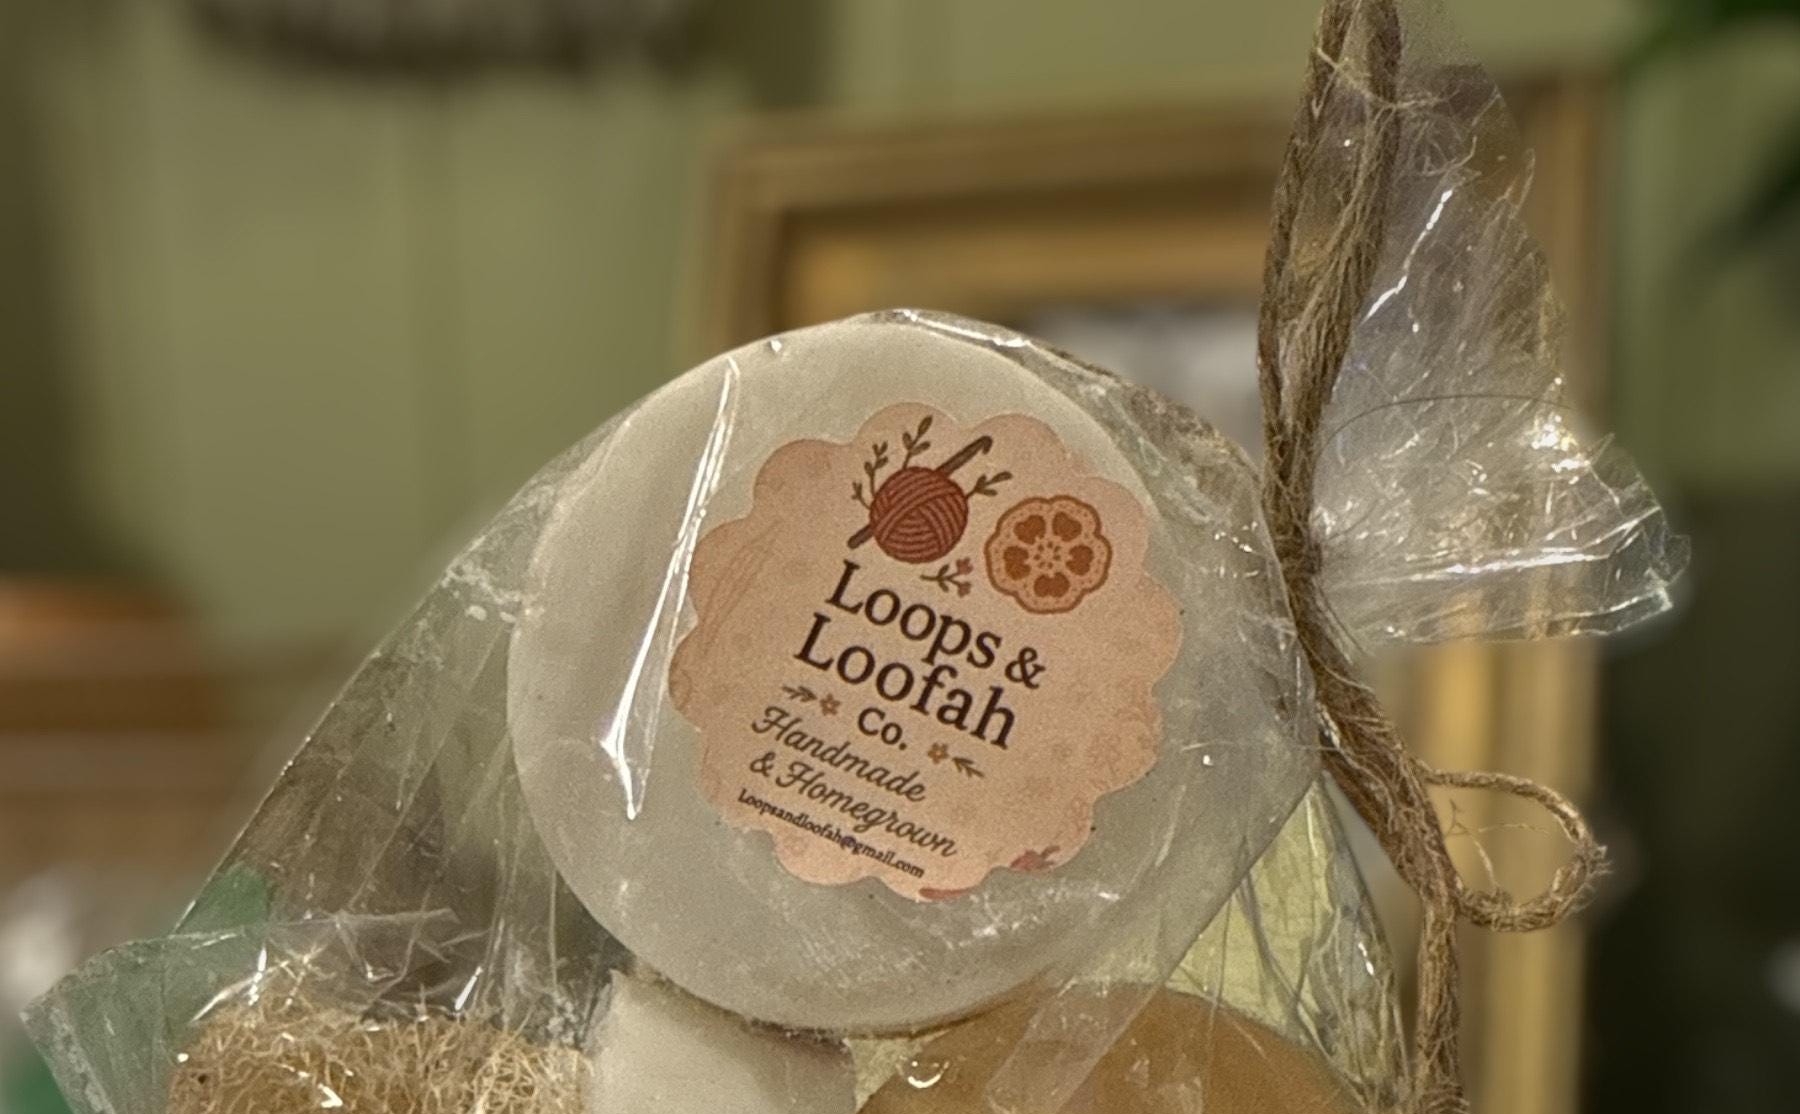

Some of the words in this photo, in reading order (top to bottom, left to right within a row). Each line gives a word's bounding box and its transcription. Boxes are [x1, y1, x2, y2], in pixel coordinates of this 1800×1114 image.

[825, 558, 1001, 670] Loops
[1004, 646, 1046, 689] &
[794, 612, 1017, 750] Loofah
[857, 706, 908, 750] Co.
[749, 751, 774, 778] &
[775, 760, 958, 858] Homegrown
[751, 705, 927, 803] Handmade
